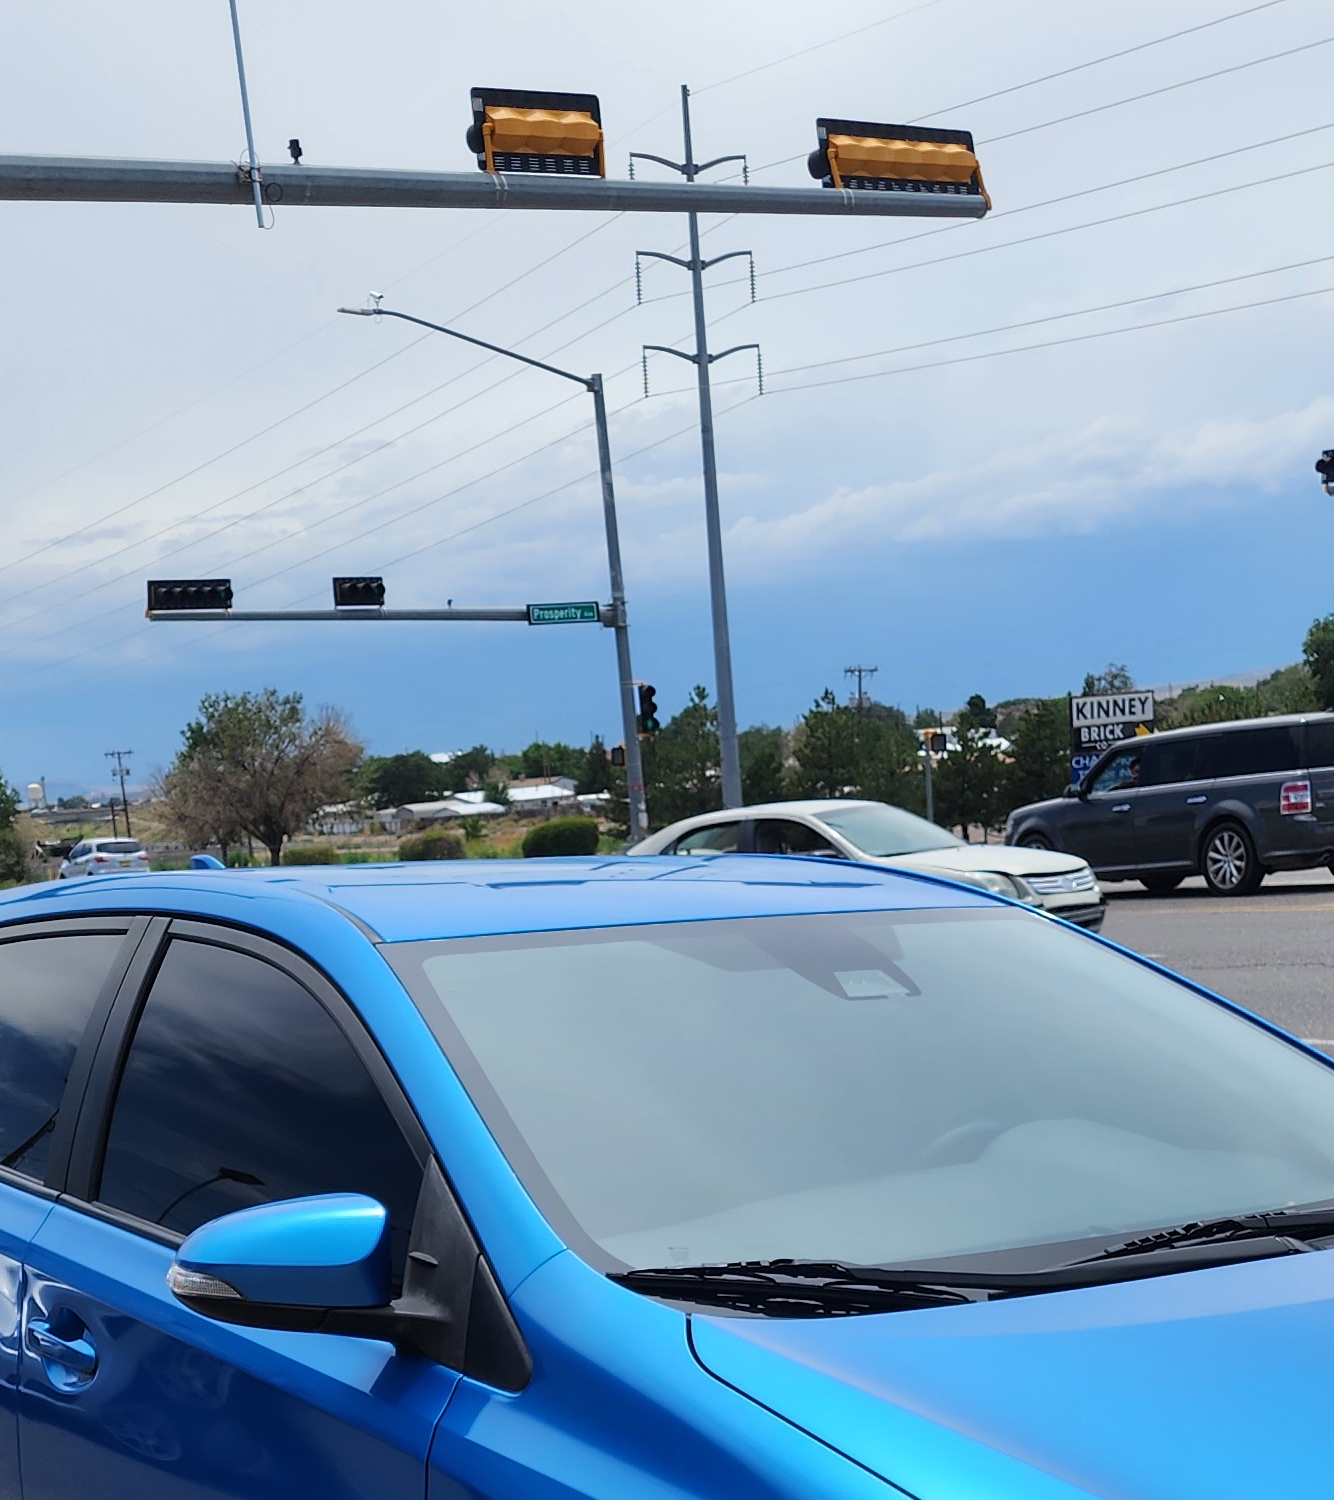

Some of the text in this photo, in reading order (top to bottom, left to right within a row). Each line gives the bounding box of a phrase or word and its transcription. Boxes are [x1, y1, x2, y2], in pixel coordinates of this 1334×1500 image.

[533, 607, 581, 619] Prosperity
[1076, 697, 1149, 720] KINNEY
[1080, 724, 1124, 742] BRICK
